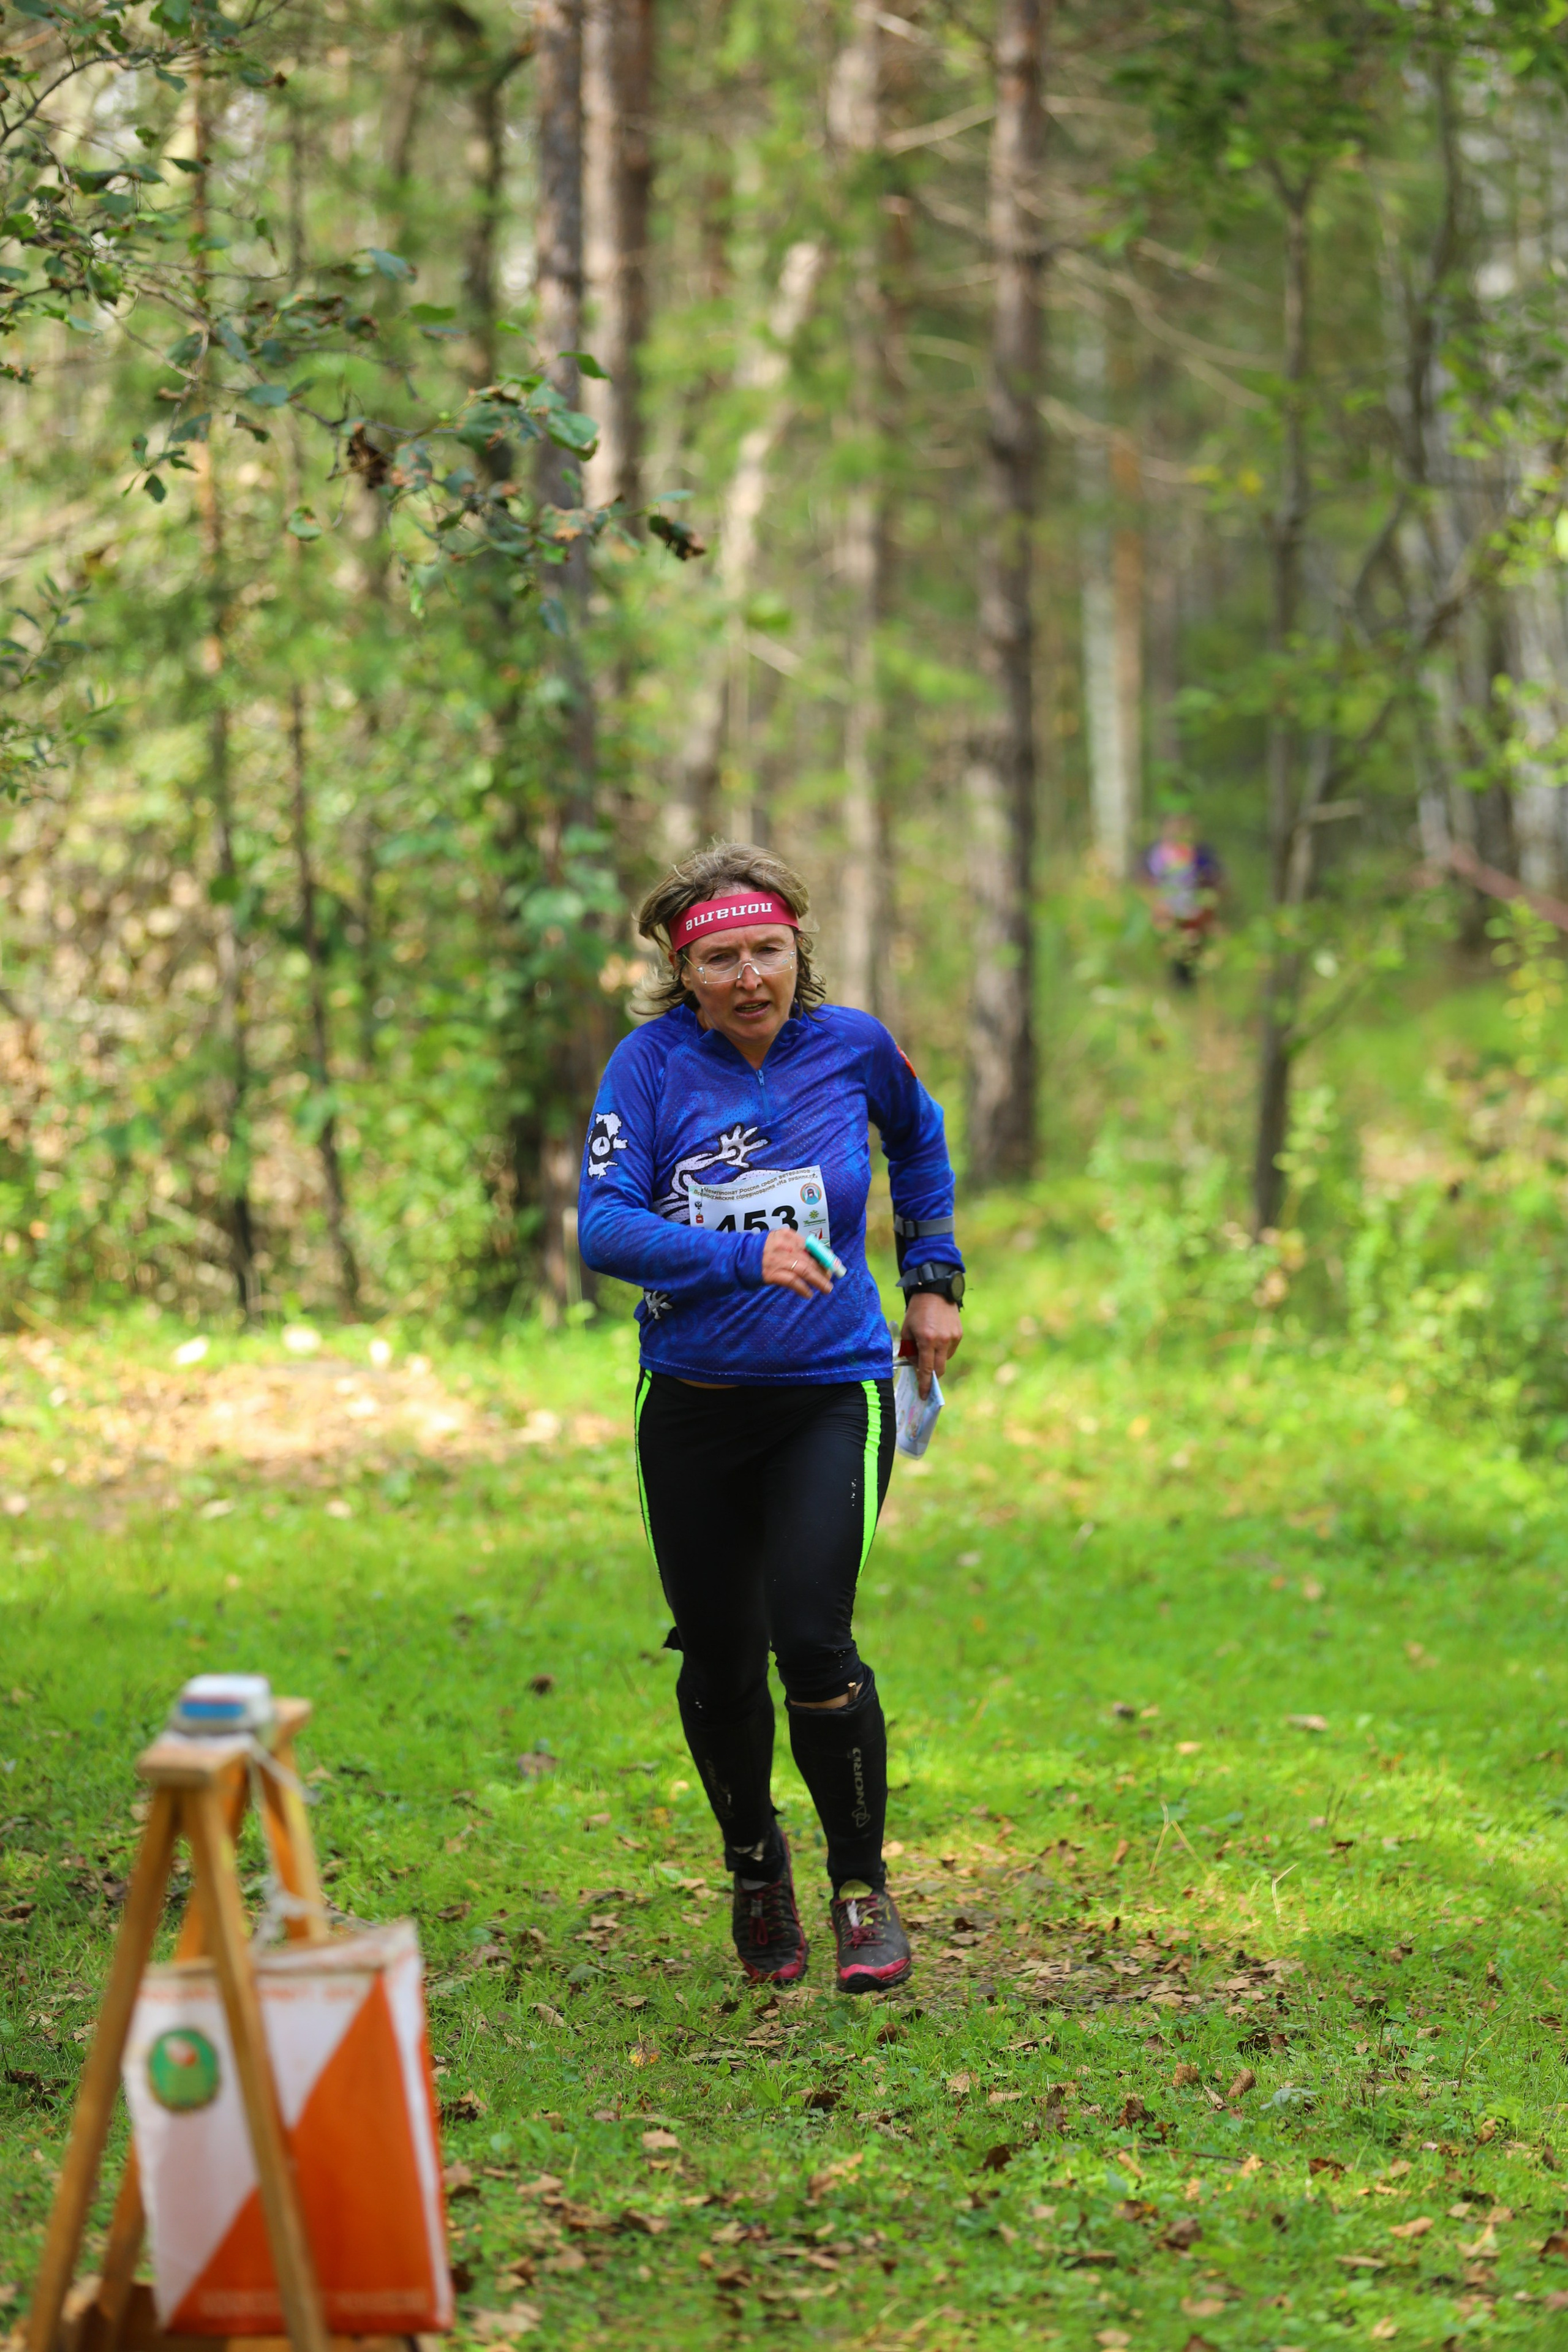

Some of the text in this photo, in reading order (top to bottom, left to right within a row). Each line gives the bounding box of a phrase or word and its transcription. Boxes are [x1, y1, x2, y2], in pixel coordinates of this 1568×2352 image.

[685, 902, 772, 931] noname
[736, 1184, 775, 1200] соревнования
[739, 1185, 760, 1194] России
[761, 1177, 777, 1187] среди
[778, 1169, 810, 1180] ветеранов
[715, 1205, 799, 1234] 453
[852, 1747, 865, 1805] NORD
